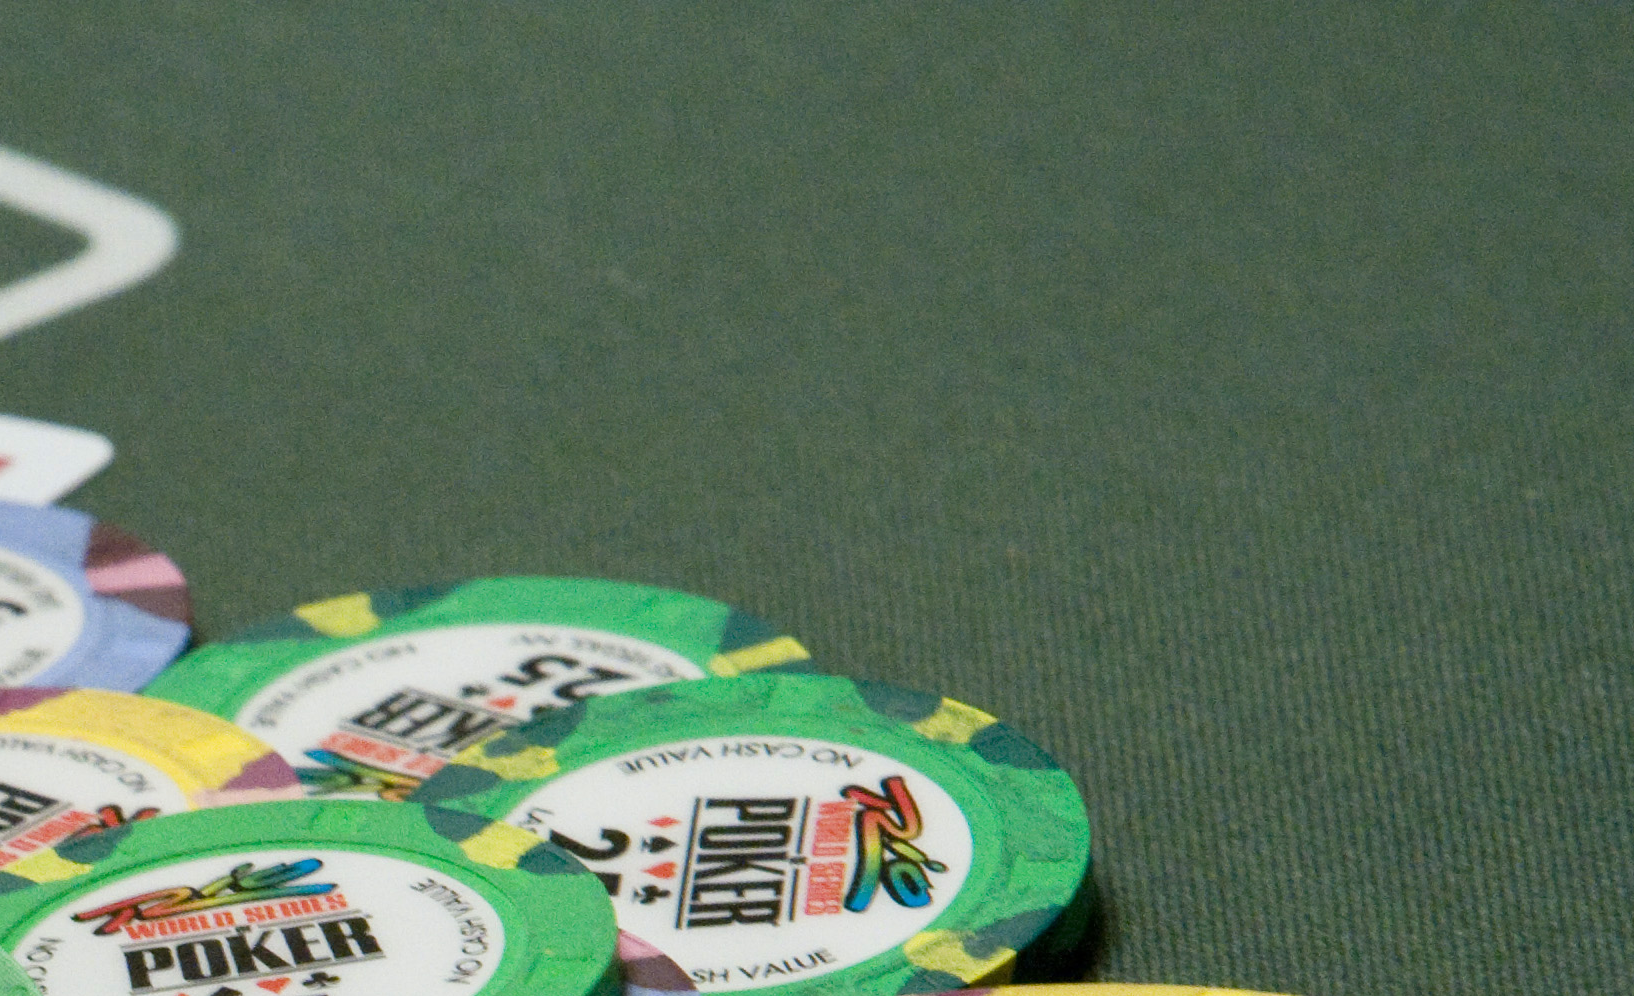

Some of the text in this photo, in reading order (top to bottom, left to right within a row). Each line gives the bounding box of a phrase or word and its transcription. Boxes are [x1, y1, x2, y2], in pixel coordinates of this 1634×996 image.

[497, 654, 636, 700] 25
[618, 742, 863, 776] NO CASH VALUE
[686, 798, 800, 928] POKER
[123, 892, 349, 941] WORLD SERIES
[26, 936, 65, 963] NO
[123, 914, 384, 991] POKER
[692, 948, 839, 985] SH VALUE
[444, 958, 483, 985] NO
